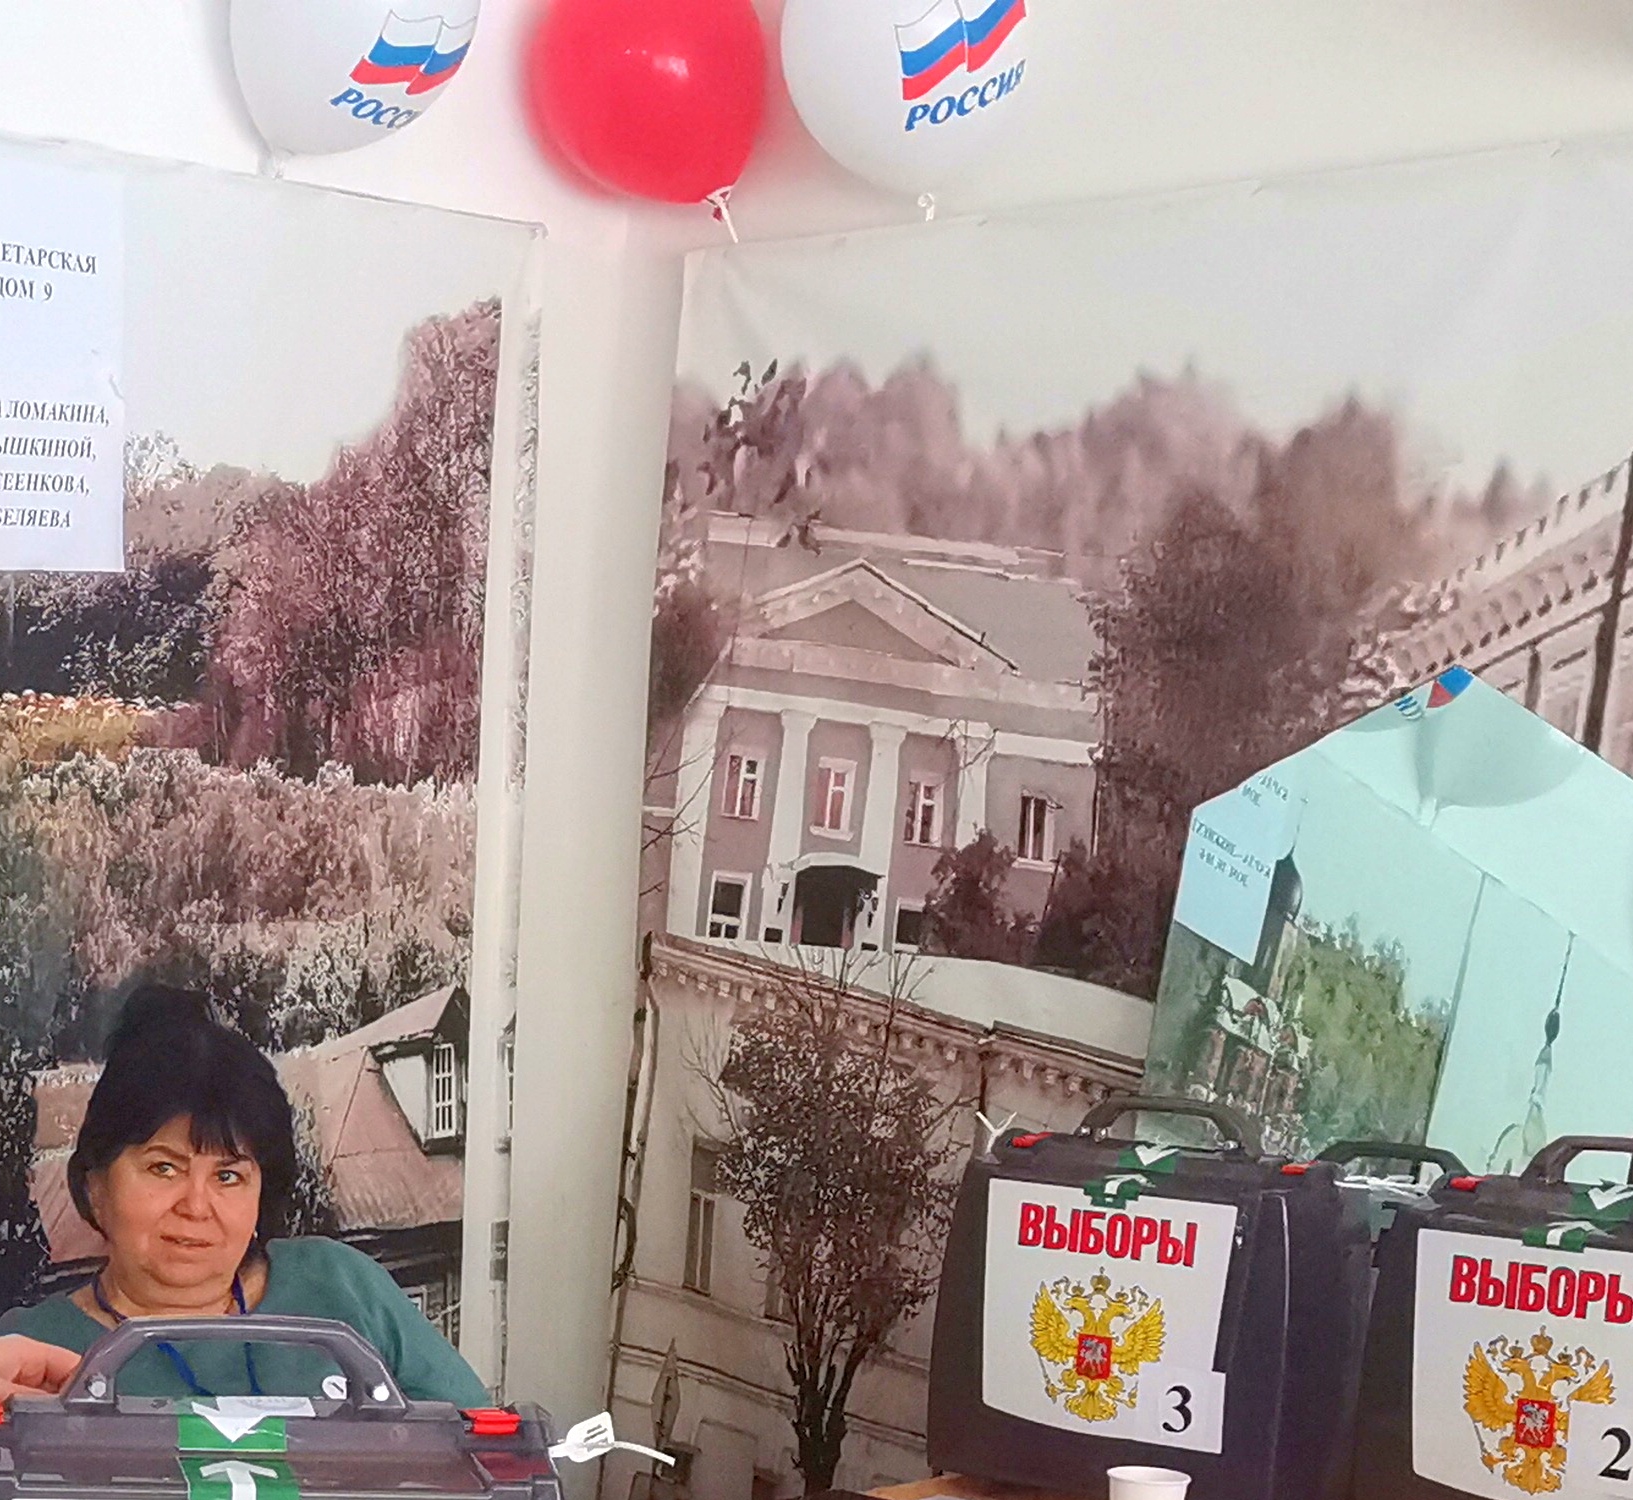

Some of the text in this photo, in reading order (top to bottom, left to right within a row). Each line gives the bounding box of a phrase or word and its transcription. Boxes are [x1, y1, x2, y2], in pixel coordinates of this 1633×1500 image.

[905, 59, 1026, 131] РОССИЯ
[43, 282, 53, 301] 9
[5, 400, 110, 428] ЛОМАКИНА,
[1018, 1202, 1198, 1268] ВЫБОРЫ
[1161, 1385, 1193, 1433] 3
[1599, 1427, 1632, 1481] 2
